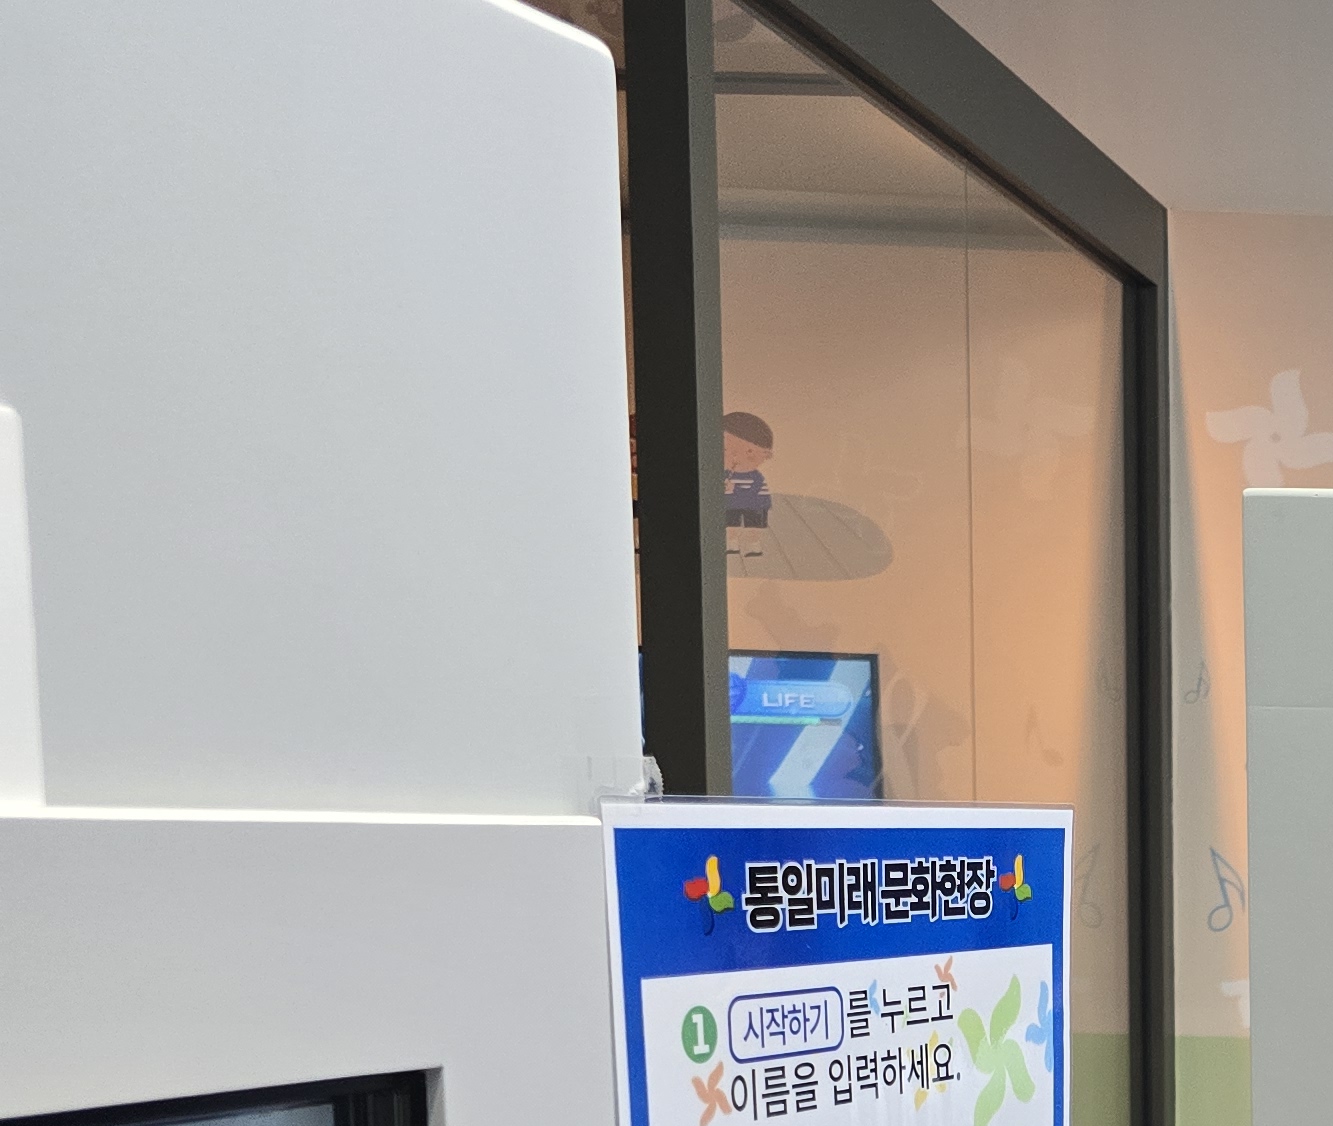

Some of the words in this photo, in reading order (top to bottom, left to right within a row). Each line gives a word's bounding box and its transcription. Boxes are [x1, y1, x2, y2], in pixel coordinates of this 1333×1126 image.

[762, 692, 815, 709] LIFE
[743, 860, 878, 931] 통일미래
[881, 857, 996, 924] 문화현장
[691, 1014, 710, 1055] 1
[743, 1000, 829, 1048] 시작하기
[881, 983, 954, 1032] 누르고
[731, 1062, 819, 1121] 이름을
[828, 1043, 962, 1107] 입력하세요.
